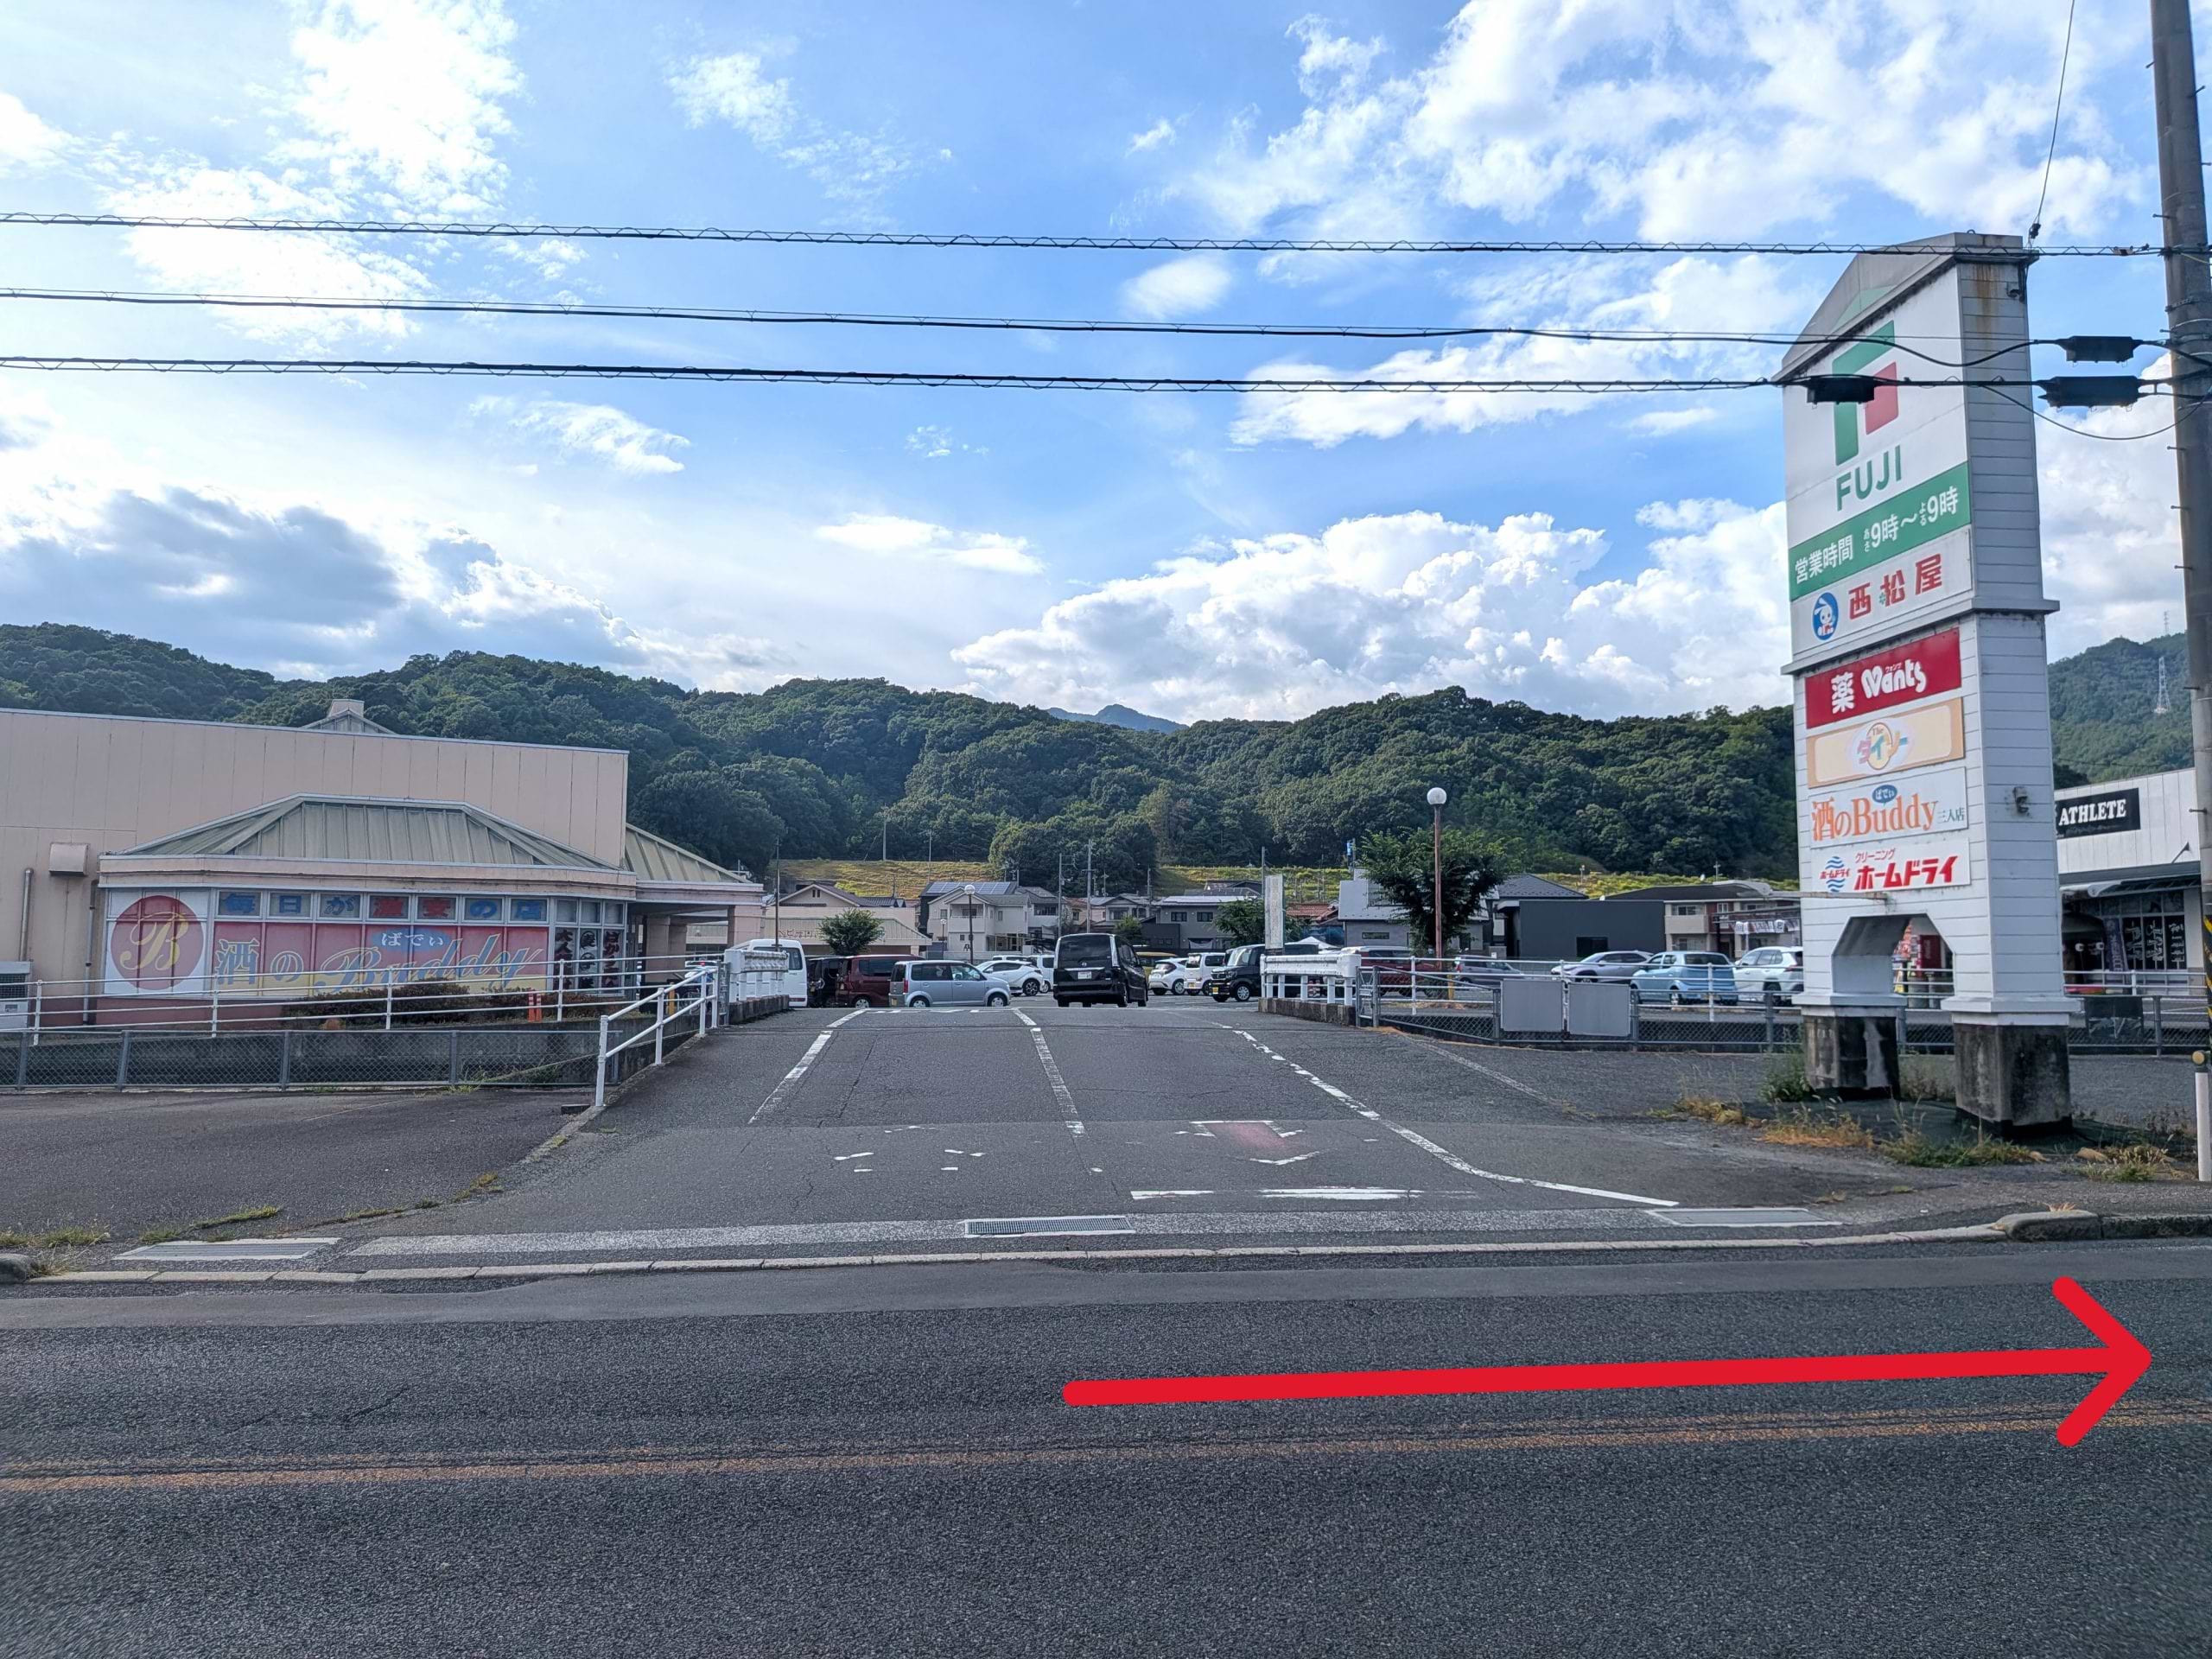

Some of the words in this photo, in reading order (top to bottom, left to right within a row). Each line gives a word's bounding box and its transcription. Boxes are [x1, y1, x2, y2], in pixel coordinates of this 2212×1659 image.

[1836, 445, 1902, 512] FUJI
[1795, 534, 1853, 584] 営業時間
[1848, 554, 1942, 620] 西松屋
[1831, 671, 1855, 714] 薬
[1860, 658, 1927, 699] Wants
[1811, 792, 1939, 842] 酒のBuddy
[2058, 798, 2126, 826] ATHLETE
[1853, 855, 1959, 891] ホームドライ
[1855, 848, 1896, 863] クリーニング
